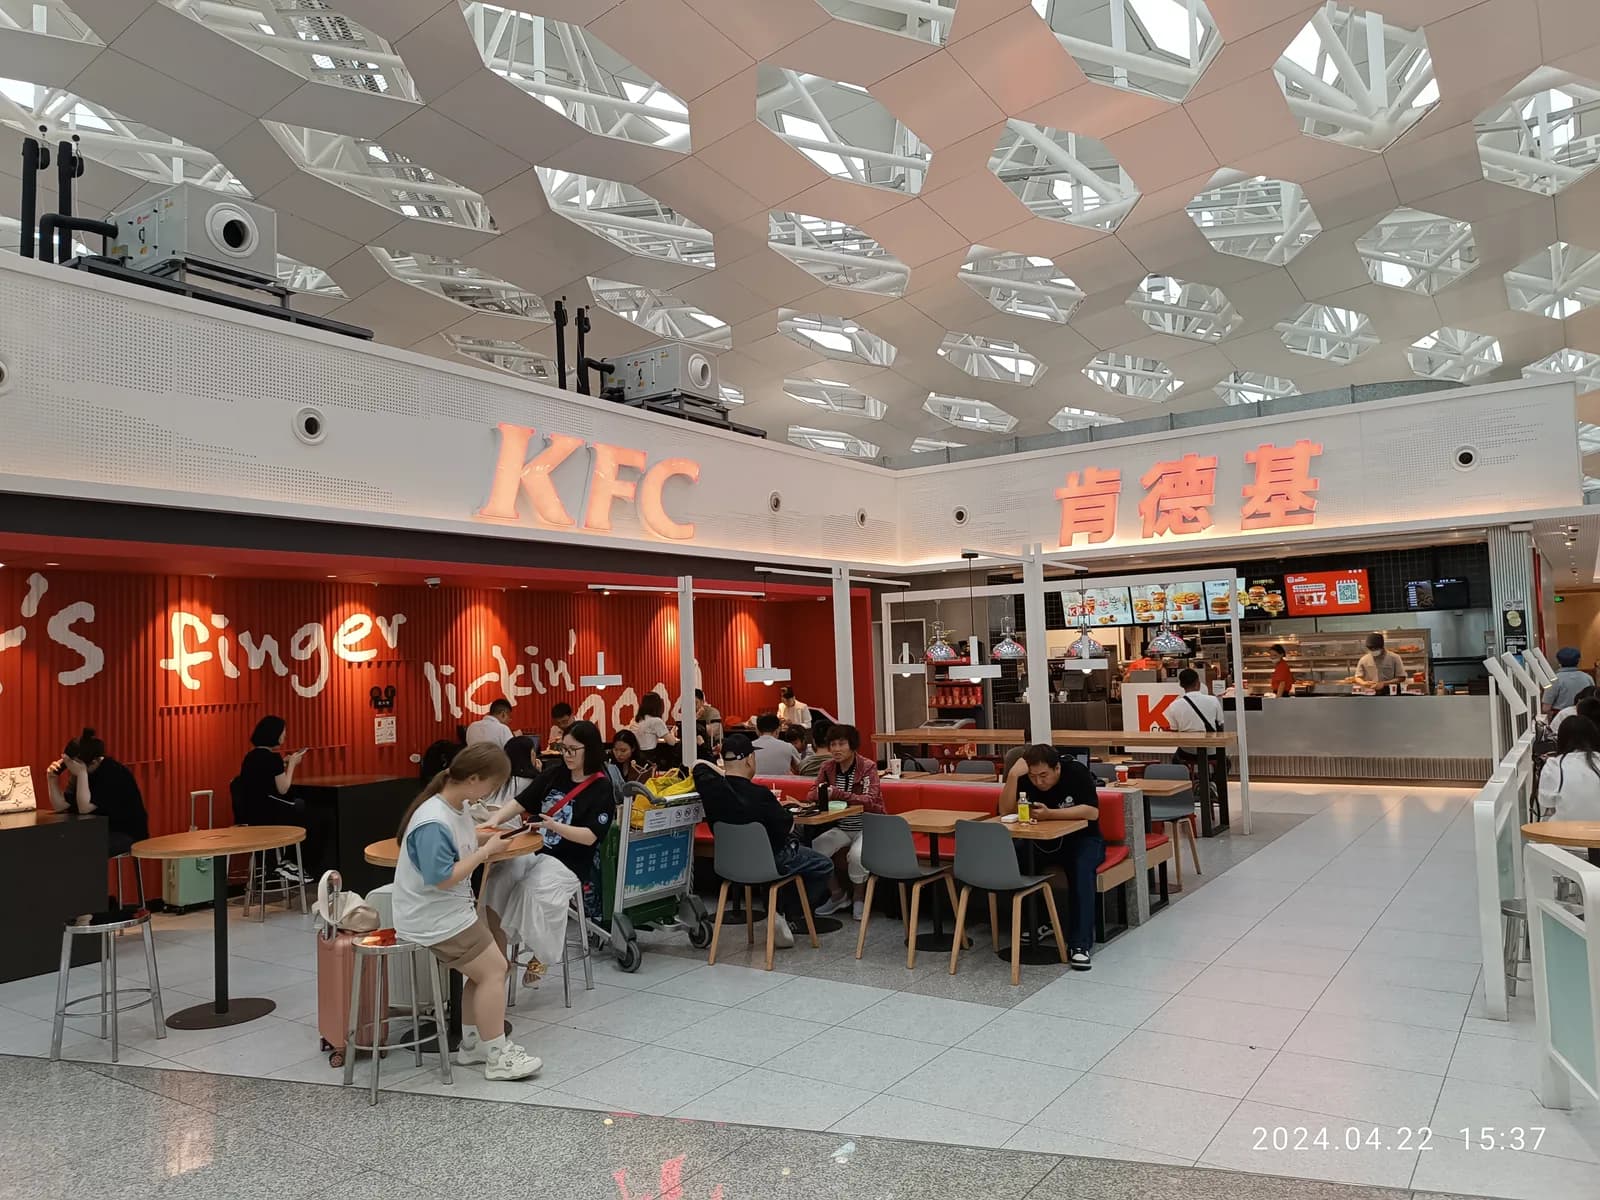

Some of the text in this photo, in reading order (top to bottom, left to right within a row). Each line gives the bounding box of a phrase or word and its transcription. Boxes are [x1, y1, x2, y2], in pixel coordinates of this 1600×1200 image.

[479, 421, 700, 540] KFC
[1055, 439, 1323, 547] 肯德基
[160, 611, 407, 697] finger
[424, 628, 577, 723] lickin'
